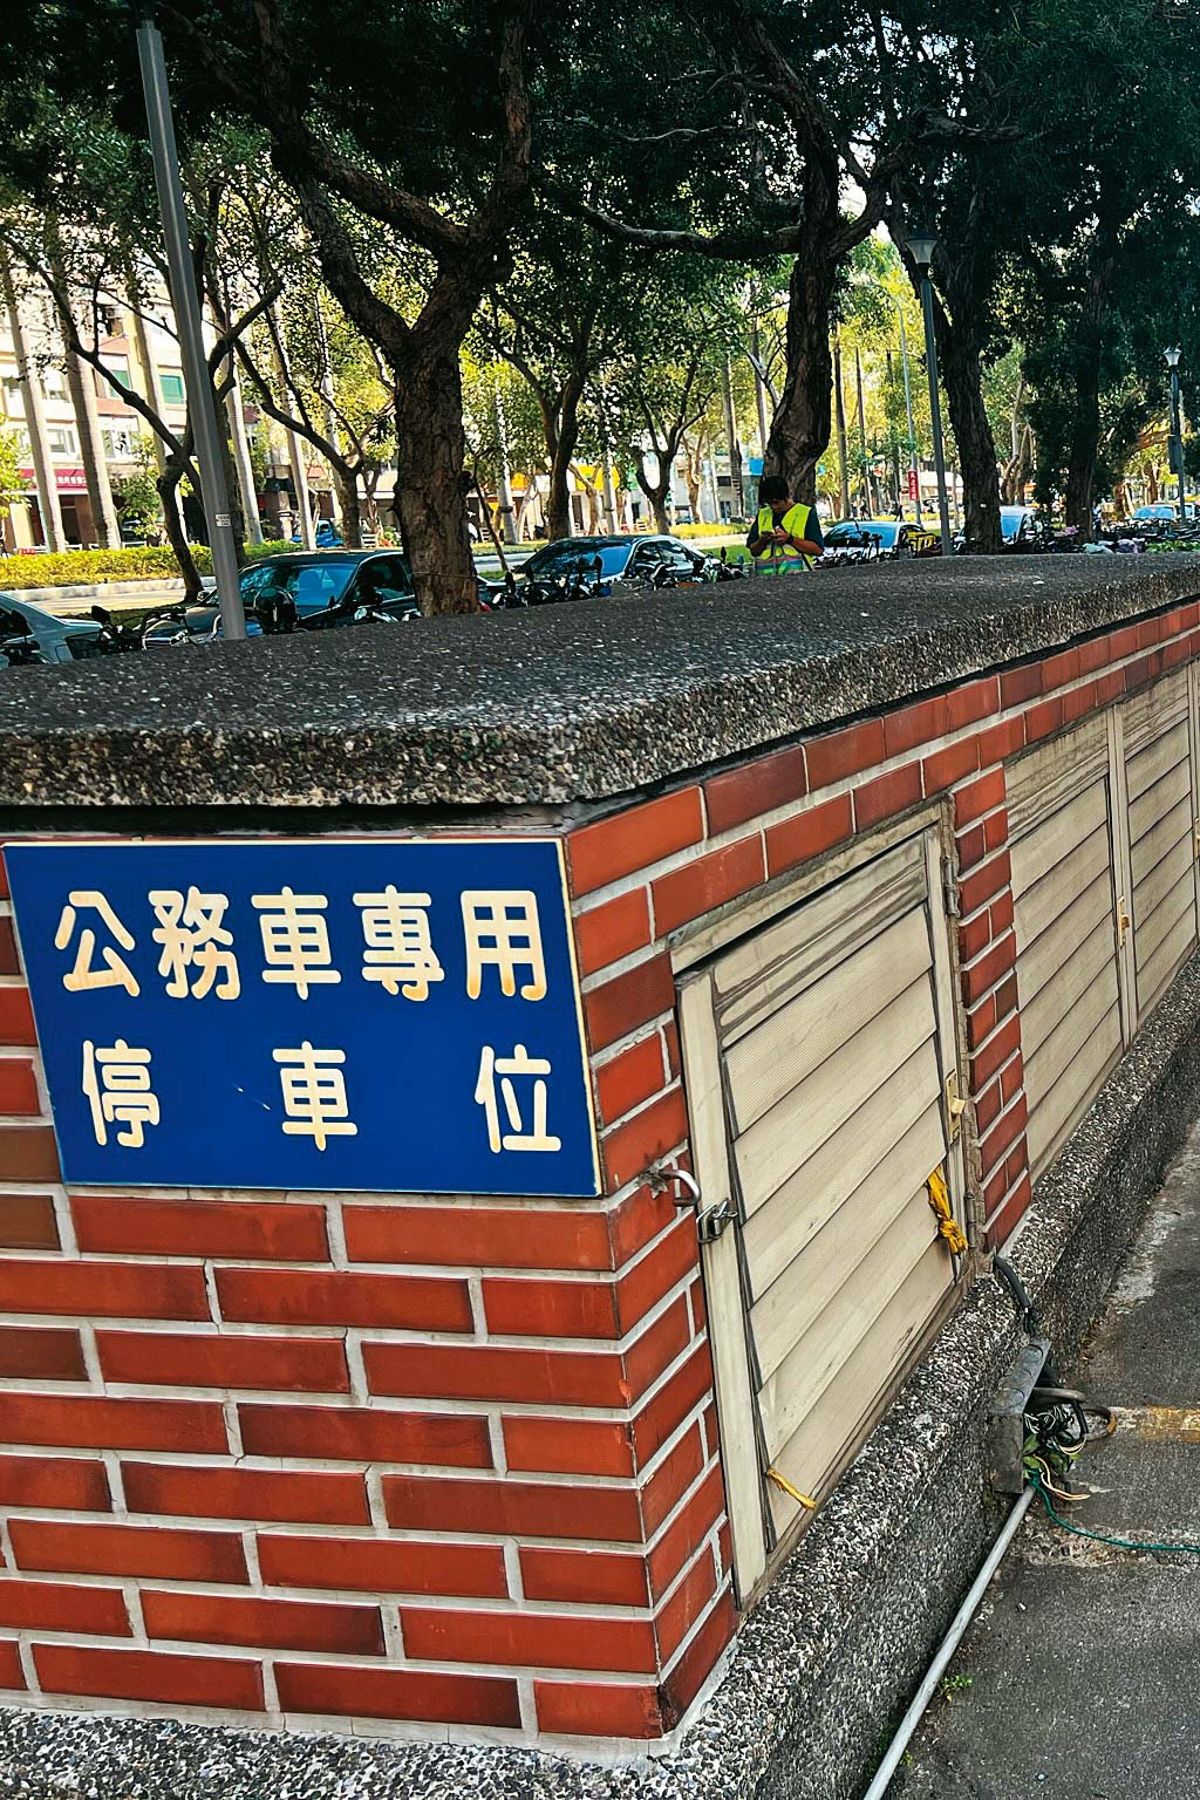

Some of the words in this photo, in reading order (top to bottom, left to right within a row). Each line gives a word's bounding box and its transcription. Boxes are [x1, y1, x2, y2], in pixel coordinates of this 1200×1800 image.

[54, 884, 548, 1002] 公務車專用
[81, 1038, 562, 1154] 停車位
